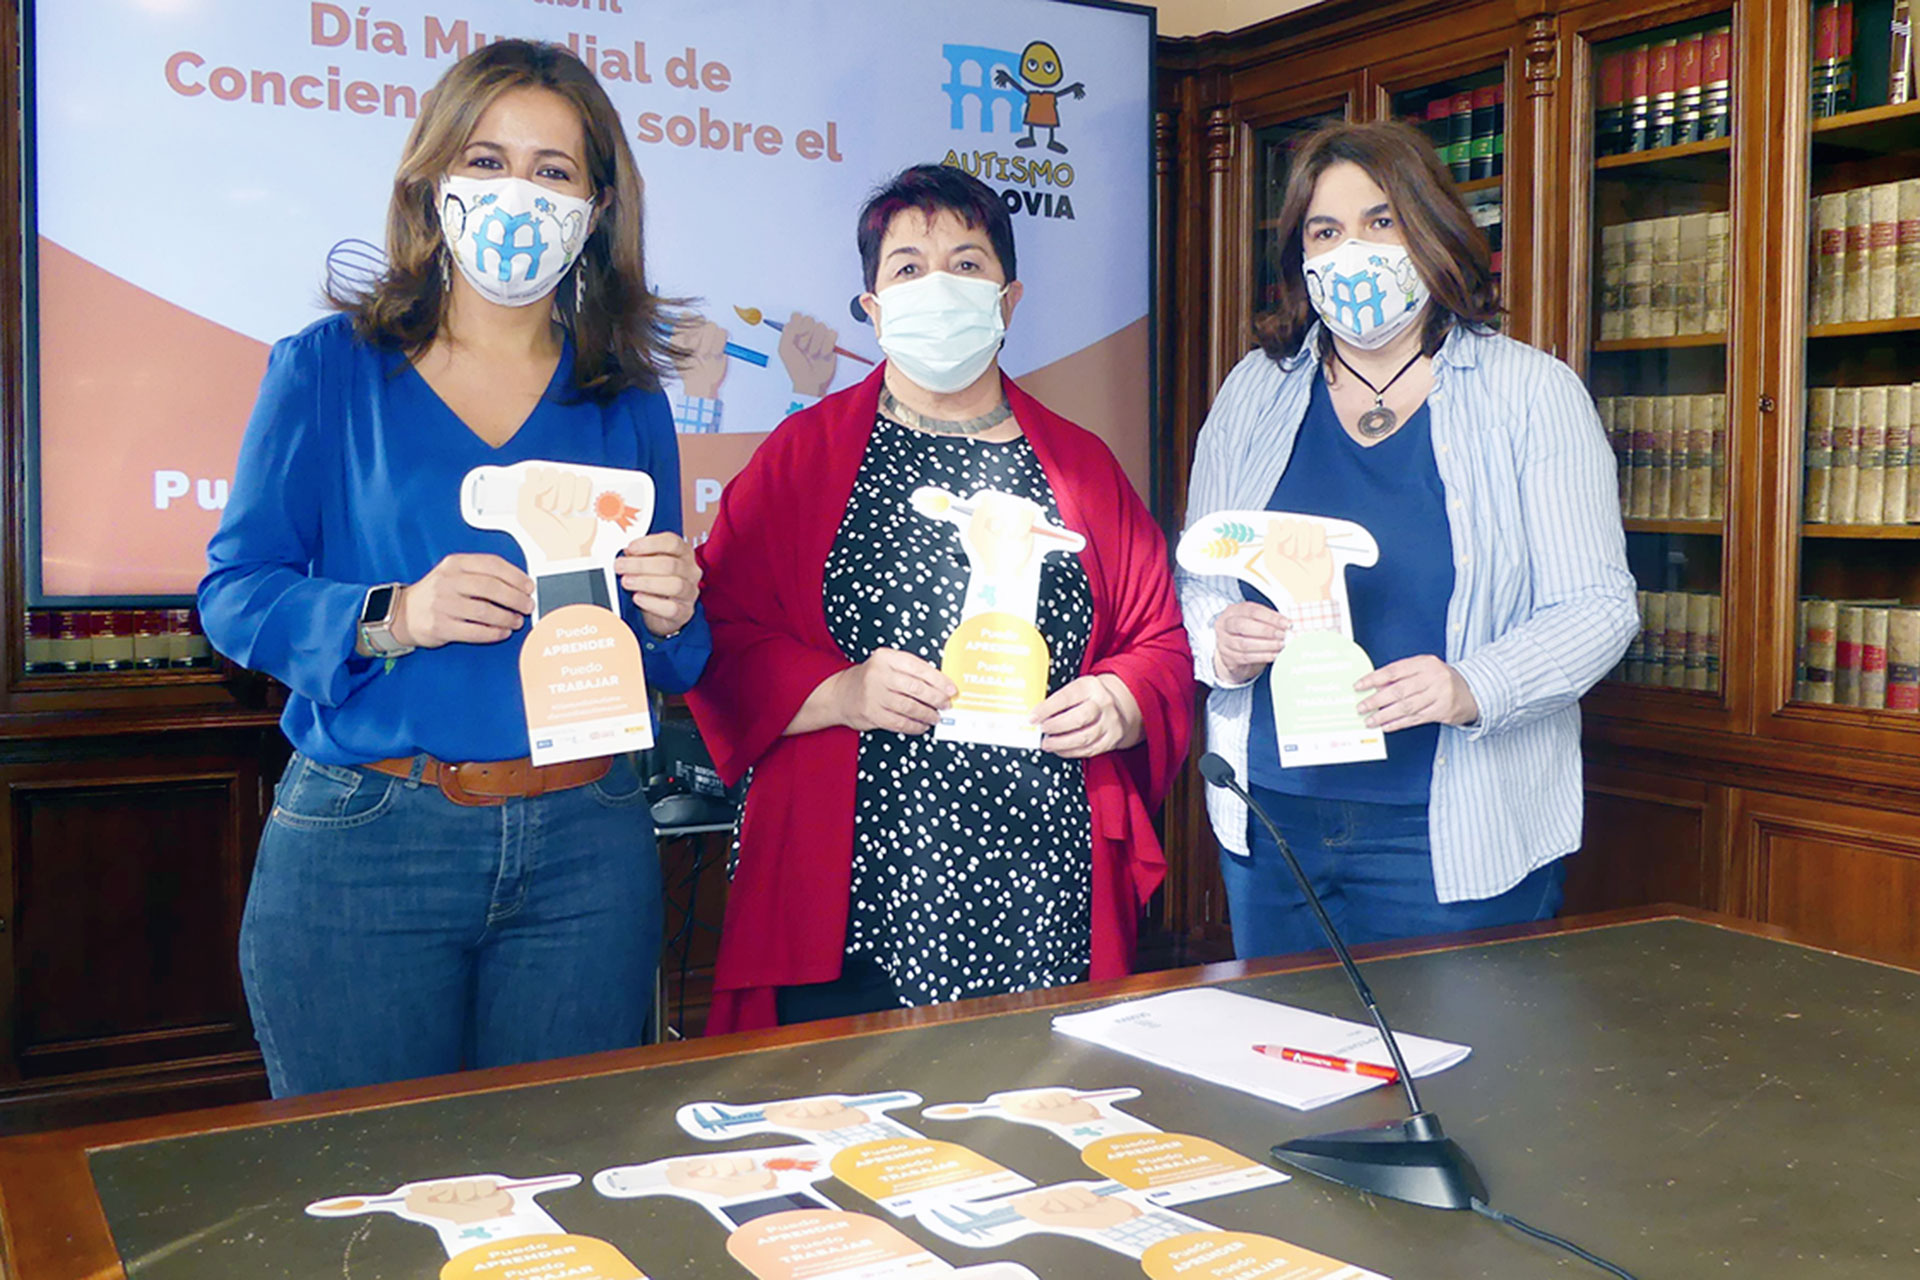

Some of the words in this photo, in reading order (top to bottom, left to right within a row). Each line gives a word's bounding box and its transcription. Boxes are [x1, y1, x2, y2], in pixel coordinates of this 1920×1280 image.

[311, 2, 407, 56] Día
[424, 15, 652, 84] Mial
[665, 47, 732, 93] de
[164, 51, 430, 119] Concien
[637, 107, 783, 156] sobre
[795, 121, 843, 162] el
[941, 149, 1074, 188] AUTISMO
[1000, 189, 1075, 220] OVIA
[557, 625, 597, 638] Puedo
[543, 638, 614, 656] APRENDER
[562, 663, 602, 676] Puedo
[548, 676, 618, 694] TRABAJAR
[473, 1246, 577, 1272] APRENDER
[488, 1242, 548, 1258] Puedo
